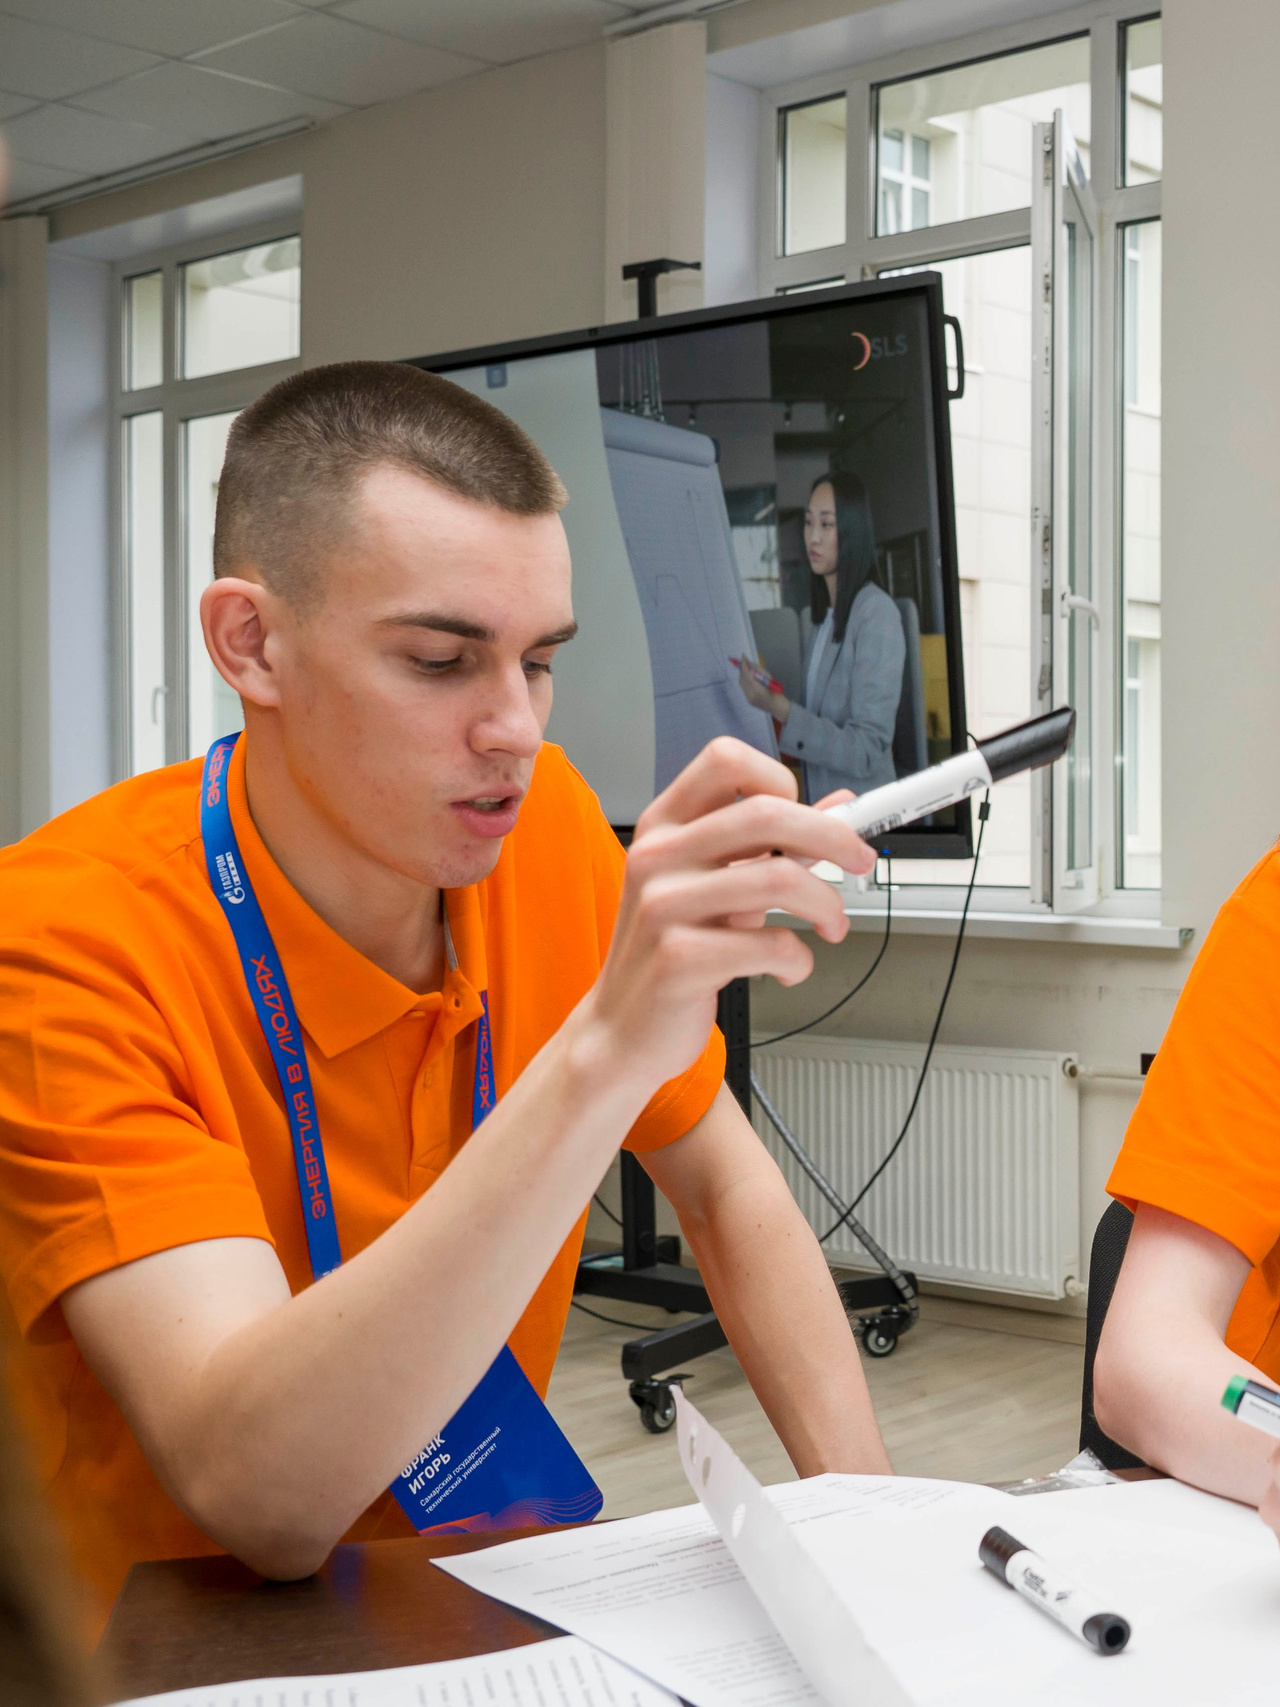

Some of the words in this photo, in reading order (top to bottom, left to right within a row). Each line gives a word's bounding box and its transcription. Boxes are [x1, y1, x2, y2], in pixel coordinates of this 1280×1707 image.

[207, 743, 236, 807] ЭНЕРГ
[215, 854, 233, 890] ГАЗПРОМ
[250, 954, 297, 1056] ЛЮДЯХ
[287, 1063, 302, 1083] В
[293, 1091, 326, 1219] ЭНЕРГИЯ
[400, 1432, 446, 1480] ФРАНК
[408, 1451, 451, 1495] ИГОРЬ
[420, 1473, 454, 1507] Самарский
[452, 1426, 502, 1475] государственный
[425, 1476, 463, 1515] технический
[462, 1442, 498, 1481] университет
